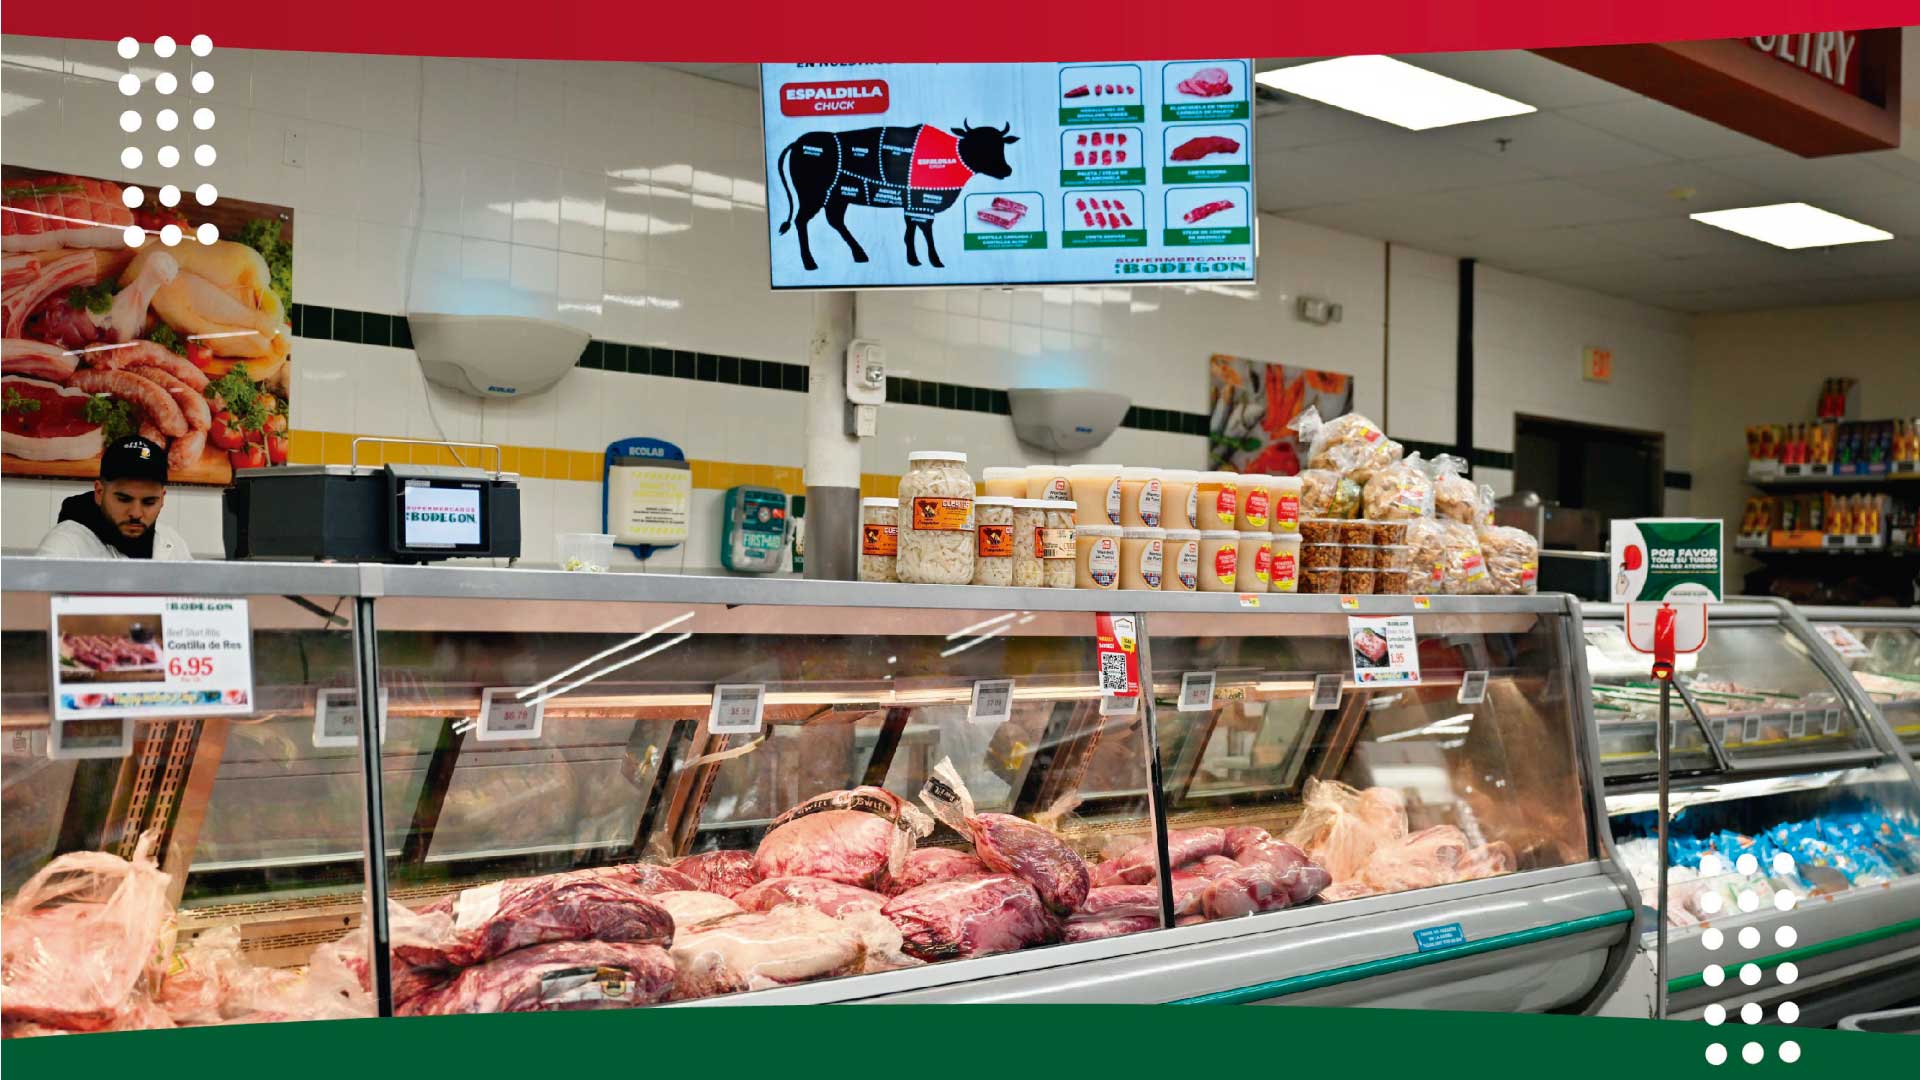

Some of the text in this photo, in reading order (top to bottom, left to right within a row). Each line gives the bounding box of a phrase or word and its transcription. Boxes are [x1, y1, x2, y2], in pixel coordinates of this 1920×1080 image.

[786, 85, 883, 100] ESPALDILLA
[813, 101, 855, 111] CHUCK
[629, 447, 665, 456] ECOLAB
[1651, 549, 1717, 557] POR FAVOR
[167, 640, 242, 650] Costilla de Res
[168, 657, 214, 676] 6.95
